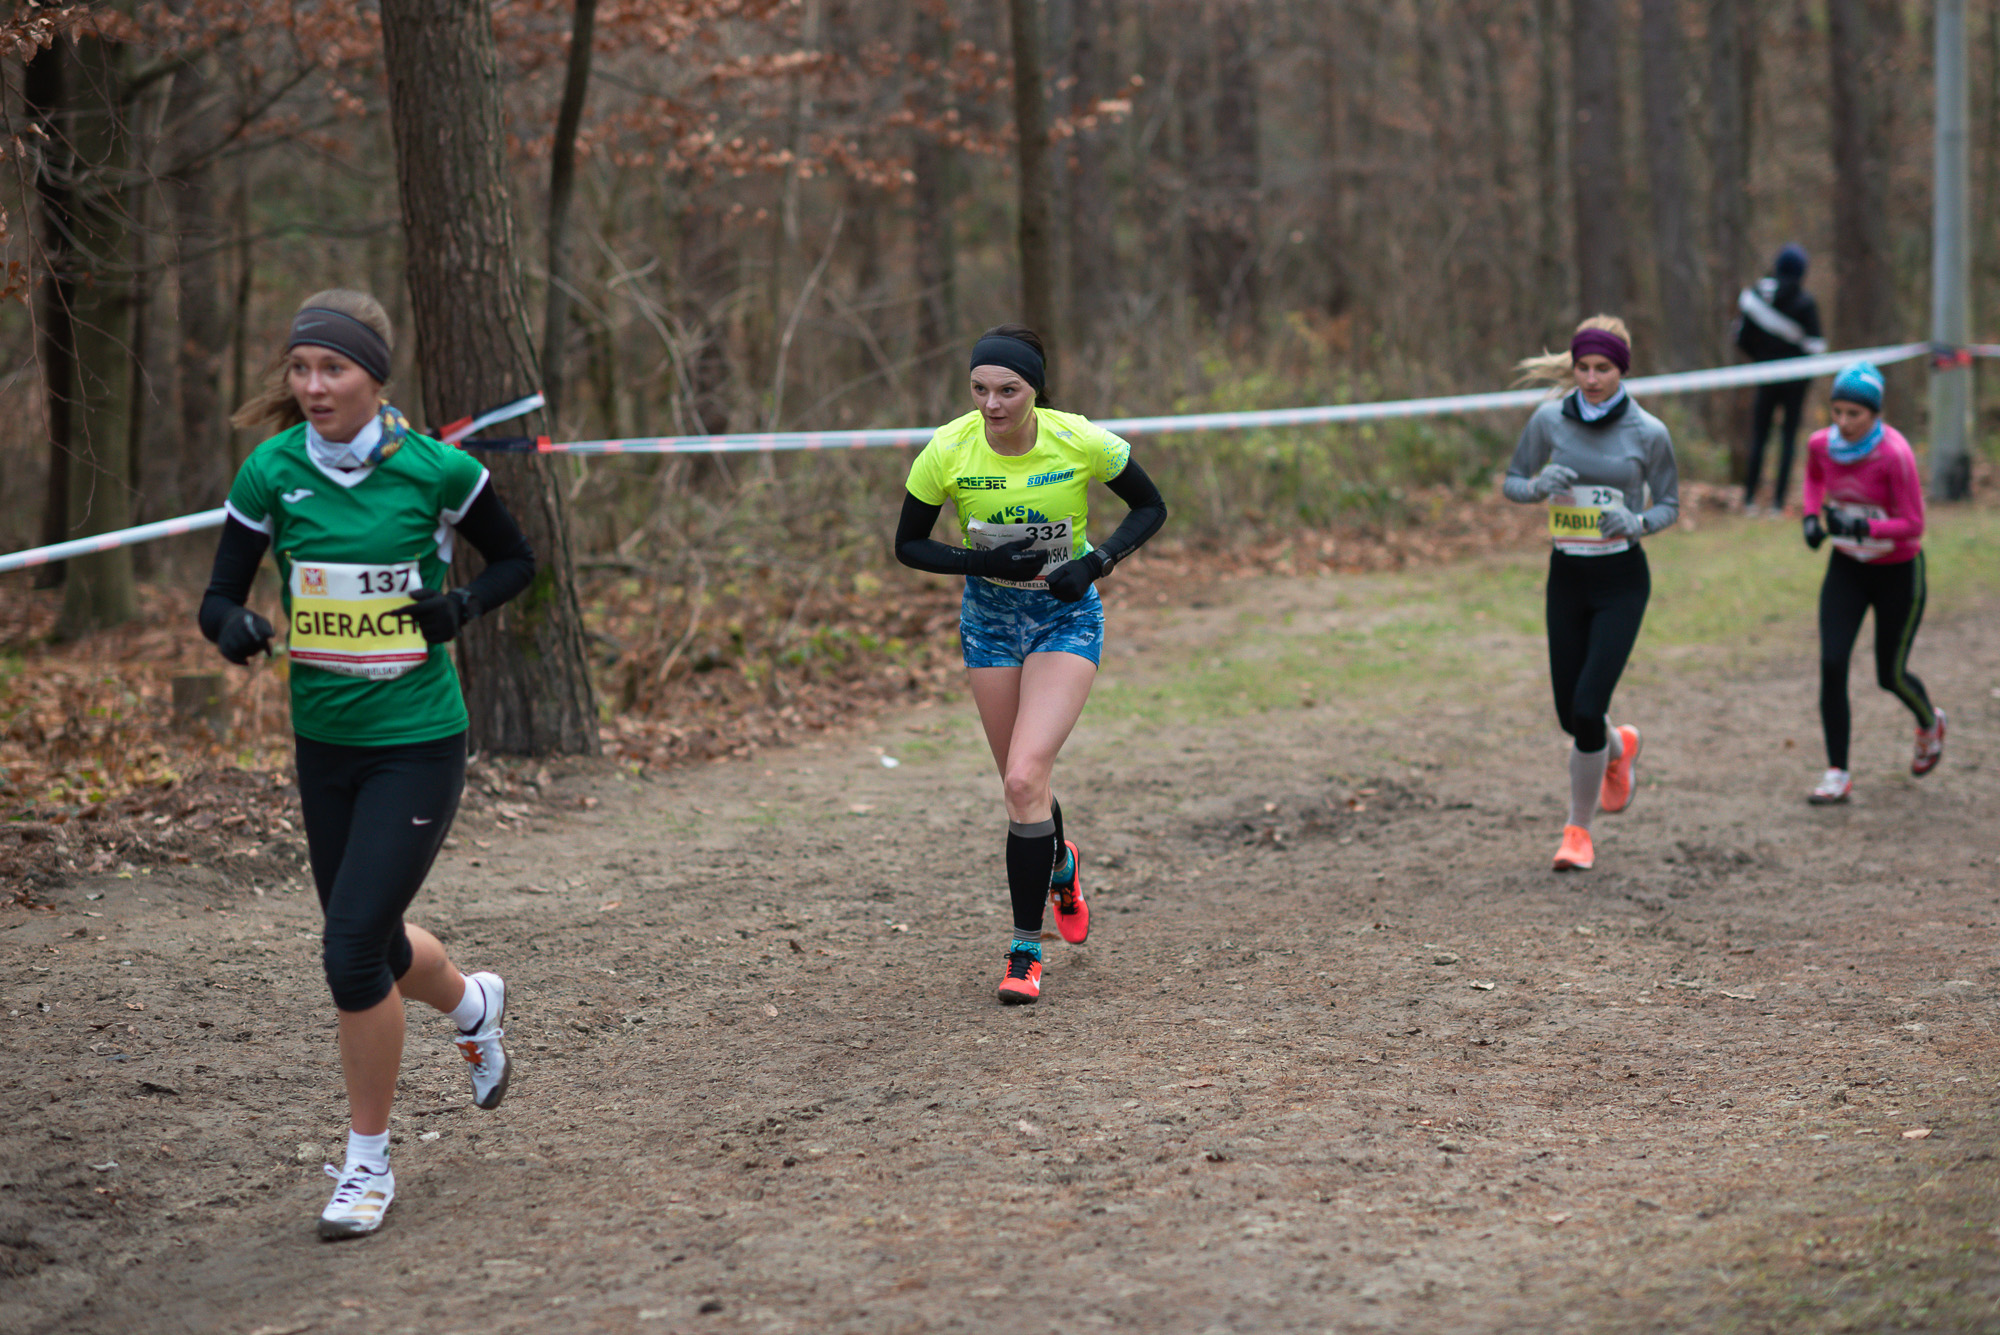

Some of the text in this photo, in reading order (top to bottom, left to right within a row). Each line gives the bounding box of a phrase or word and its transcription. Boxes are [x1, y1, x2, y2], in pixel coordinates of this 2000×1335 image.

[1027, 468, 1075, 487] SONAROL
[1592, 490, 1612, 505] 25
[1005, 505, 1026, 518] KS
[1025, 523, 1067, 541] 332
[358, 568, 410, 594] 137
[1018, 580, 1049, 589] LUBELSK
[296, 611, 416, 638] GIERACH
